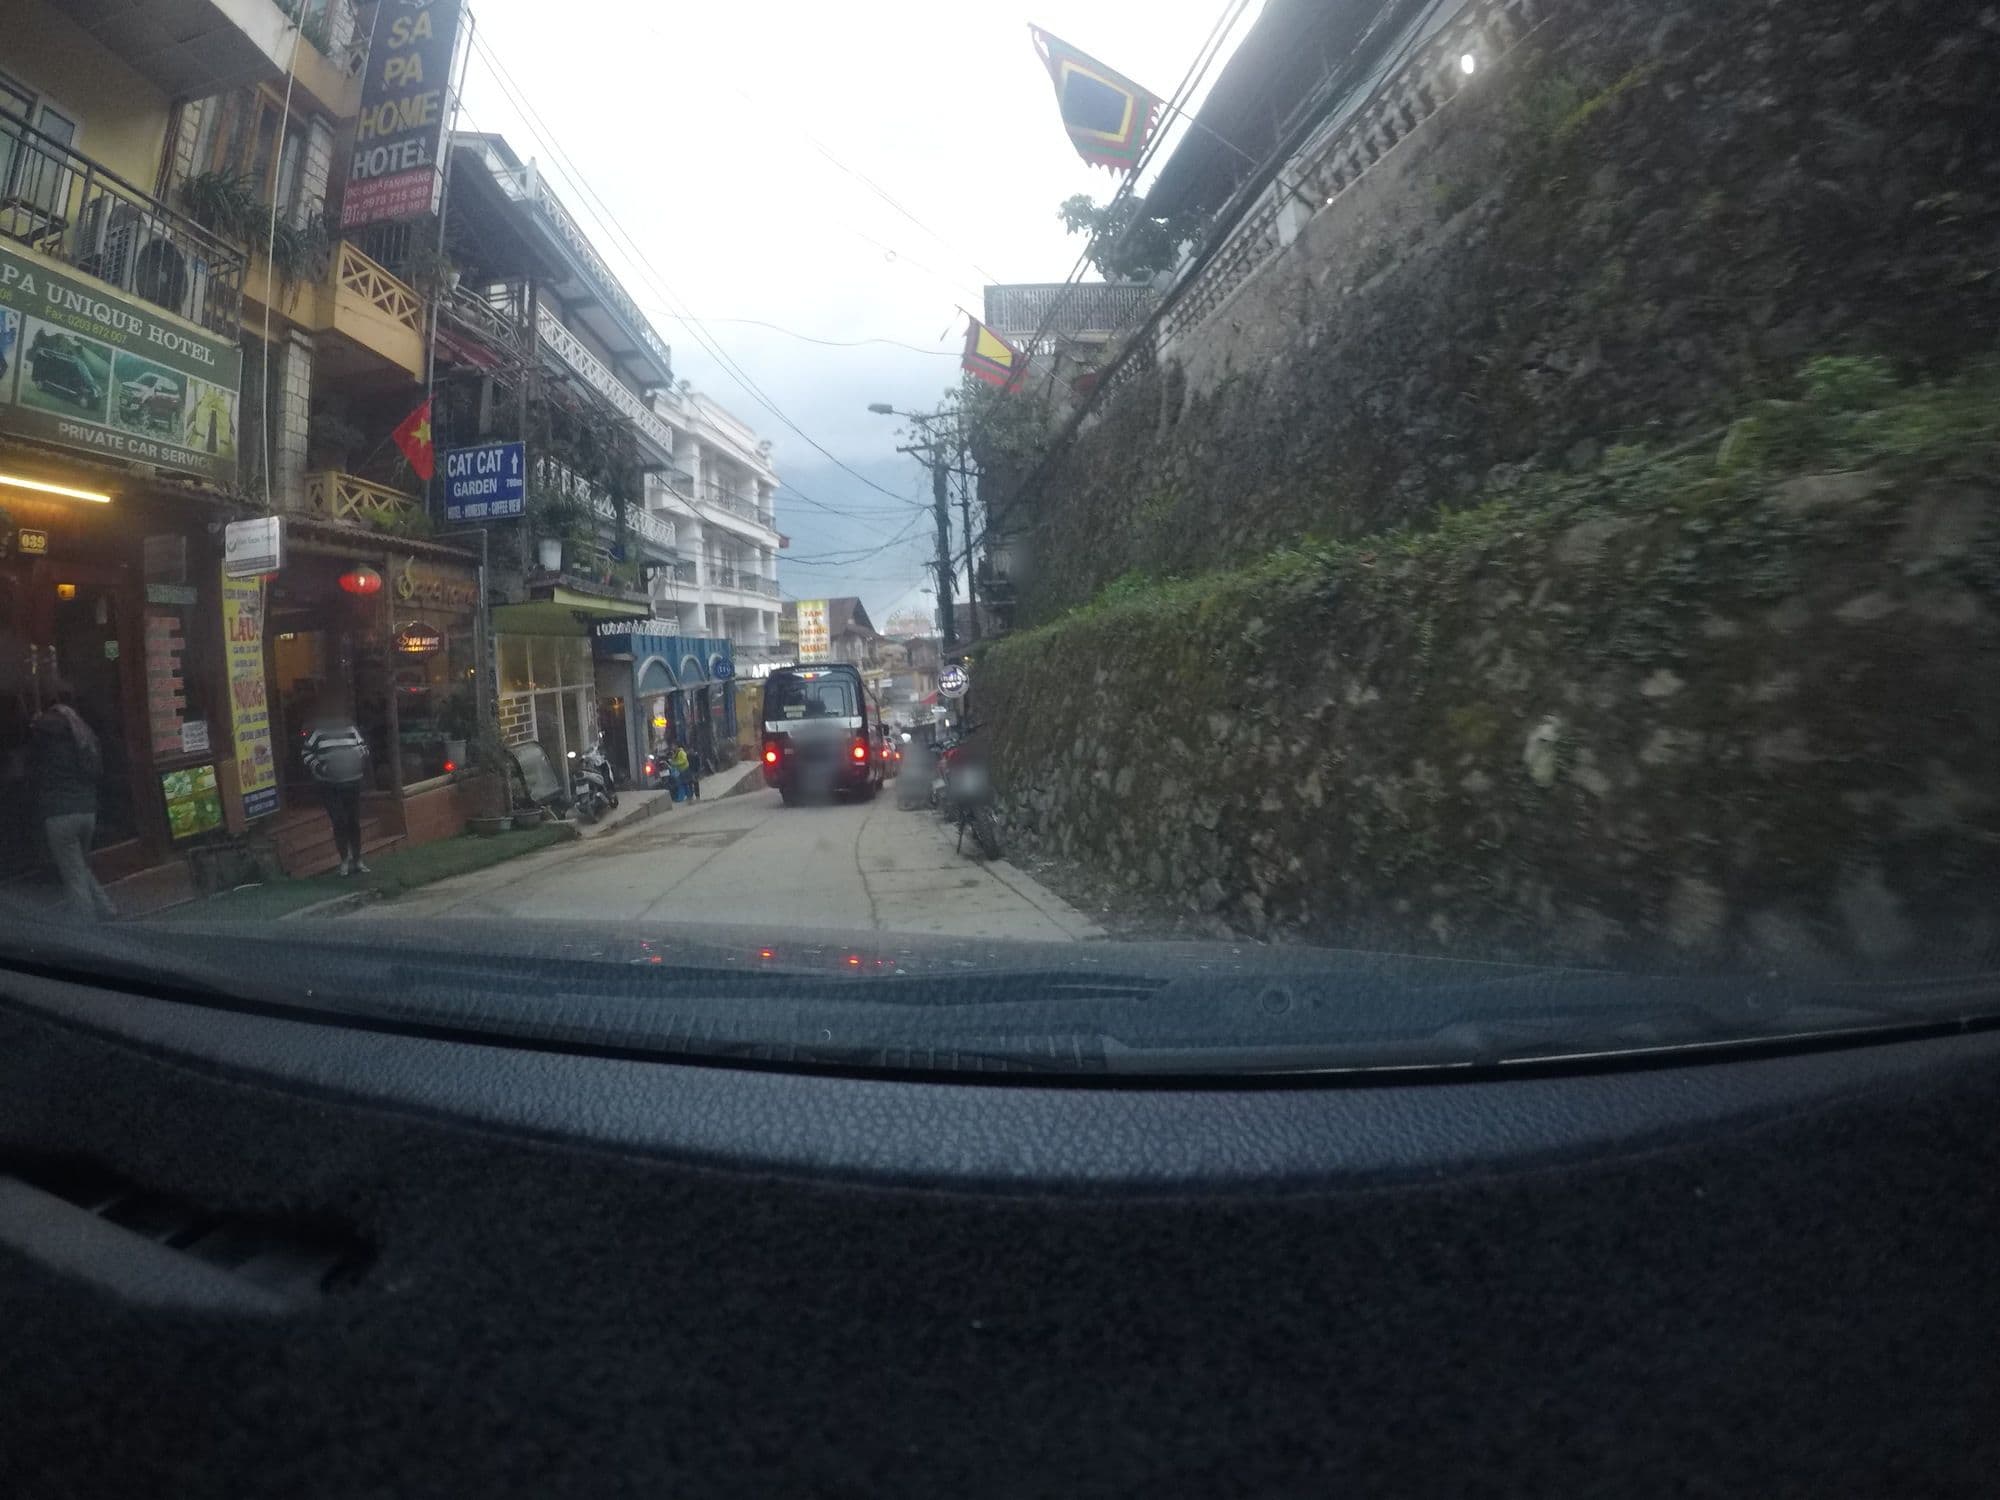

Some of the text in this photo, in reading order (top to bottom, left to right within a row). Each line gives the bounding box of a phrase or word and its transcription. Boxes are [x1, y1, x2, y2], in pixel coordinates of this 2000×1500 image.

[387, 10, 433, 49] SA
[382, 53, 424, 91] PA
[357, 90, 440, 142] HOME
[352, 137, 432, 180] HOTEL
[1, 263, 215, 366] PA UNIQUE HOTEL
[58, 421, 124, 449] PRIVATE
[128, 439, 157, 460] CAR
[448, 449, 503, 478] CAT CAT
[454, 478, 498, 497] GARDEN
[22, 534, 45, 548] 039
